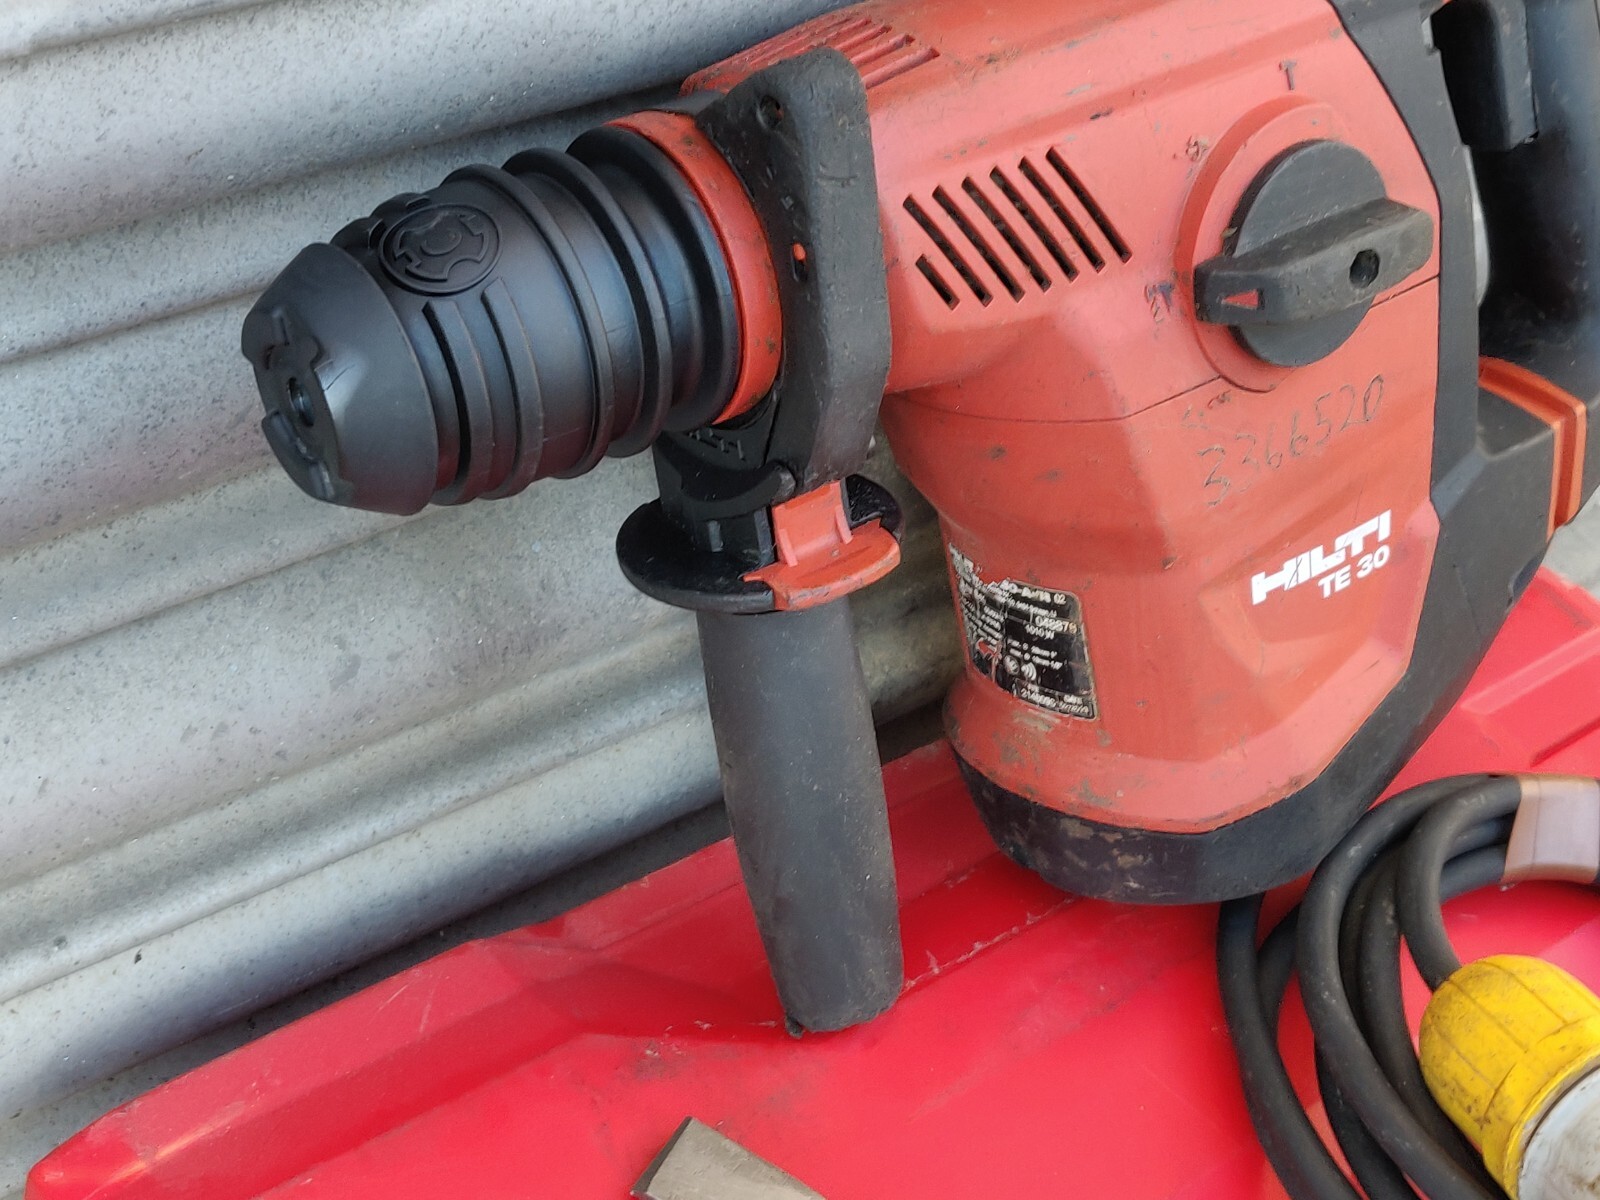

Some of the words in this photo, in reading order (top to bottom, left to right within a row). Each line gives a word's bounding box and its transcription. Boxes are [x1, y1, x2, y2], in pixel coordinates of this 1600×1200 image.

[1251, 509, 1391, 605] HILTI
[1318, 564, 1351, 598] TE
[1356, 544, 1390, 579] 30
